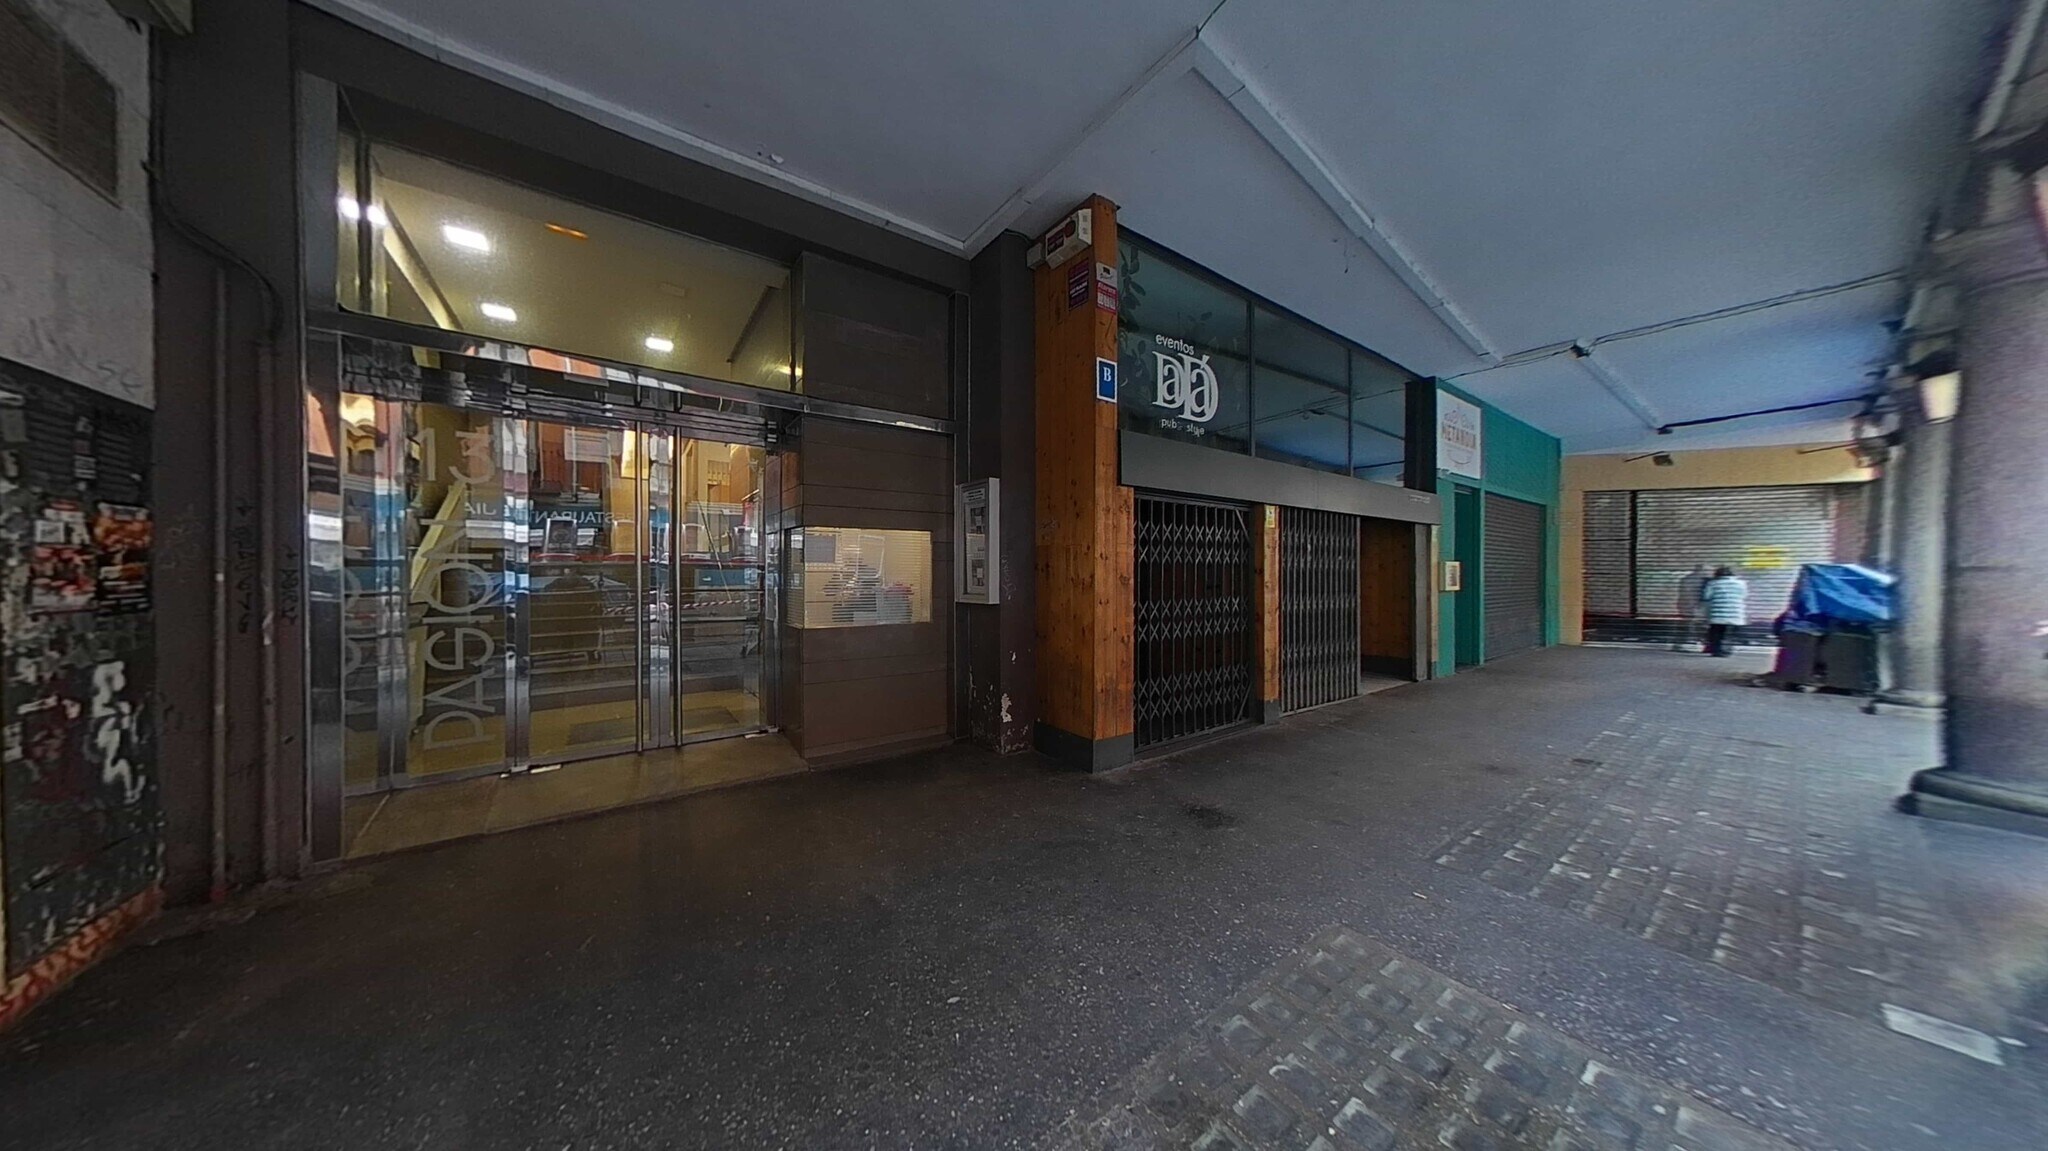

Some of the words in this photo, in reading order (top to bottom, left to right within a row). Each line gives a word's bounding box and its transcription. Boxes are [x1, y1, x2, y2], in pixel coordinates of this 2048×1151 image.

[1156, 334, 1194, 355] eventos
[1103, 366, 1112, 382] B
[1161, 418, 1177, 429] pub
